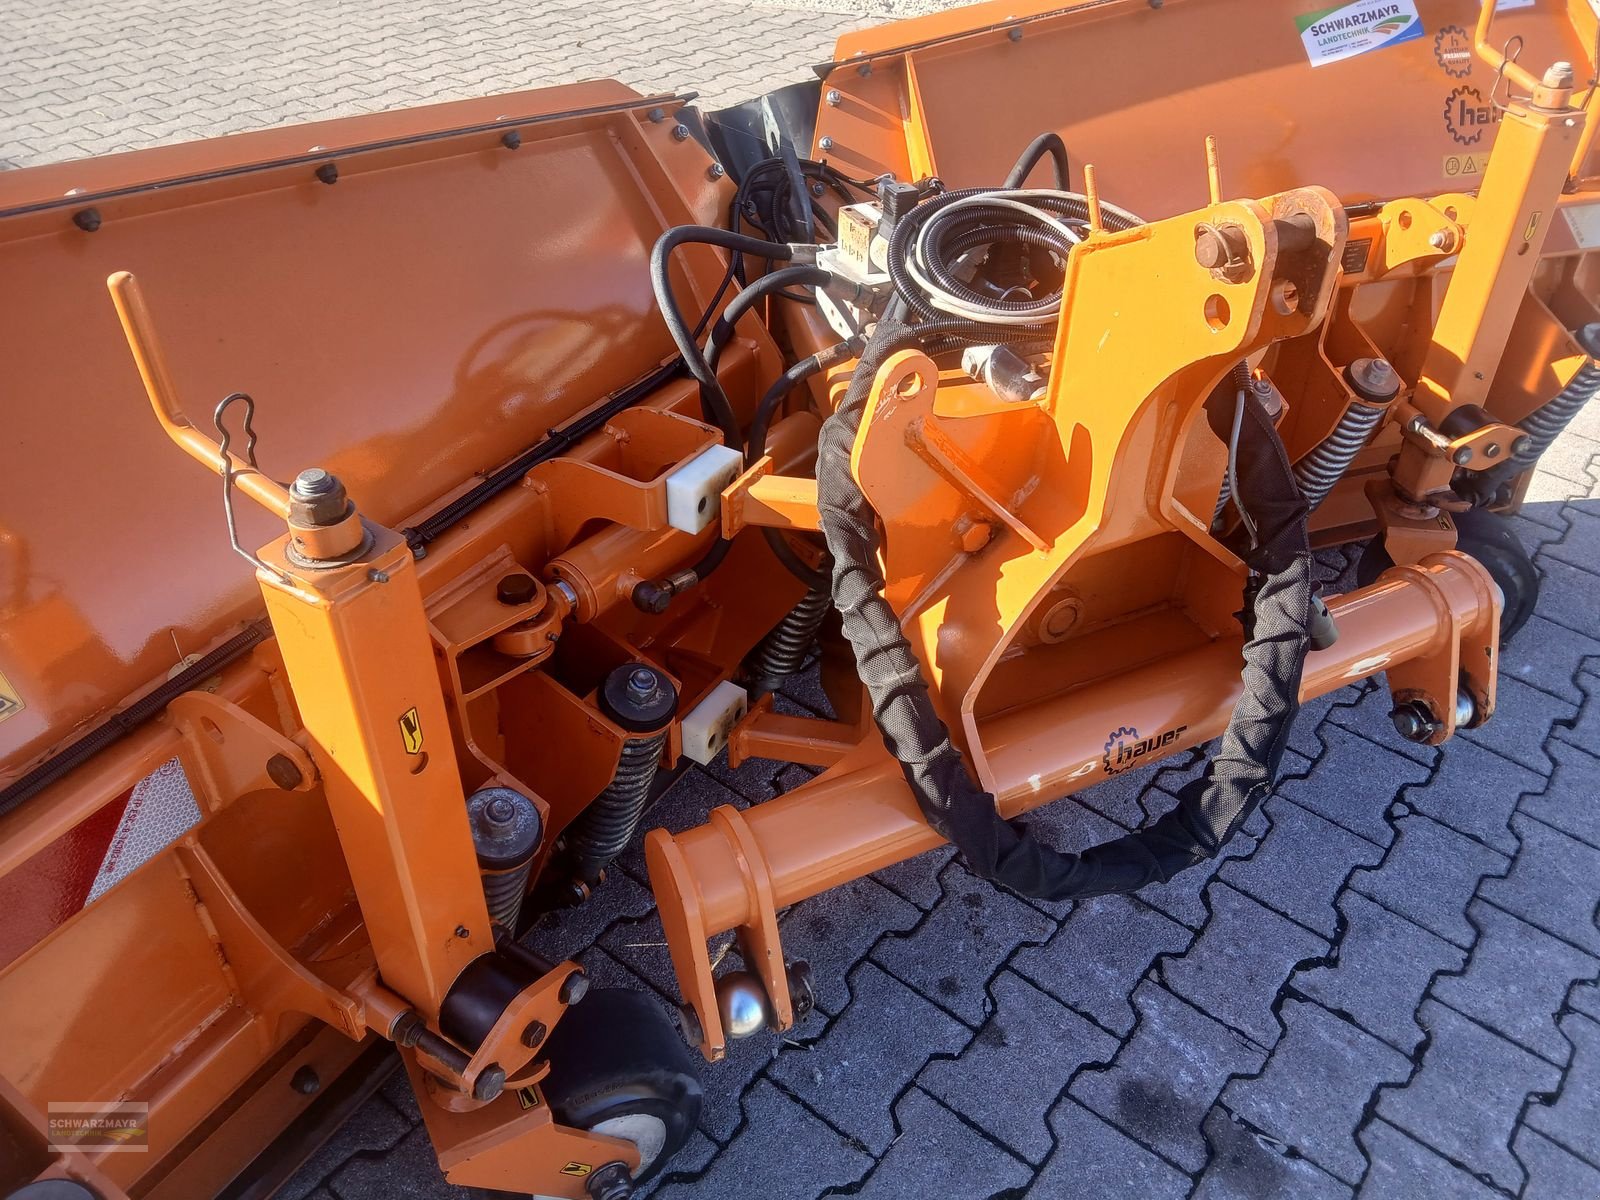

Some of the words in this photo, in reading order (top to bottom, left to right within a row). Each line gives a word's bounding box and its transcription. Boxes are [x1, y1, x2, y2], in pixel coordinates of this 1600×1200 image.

[1311, 4, 1400, 37] SCHWARZMAYR
[1317, 27, 1370, 46] LANDTECHNIK
[1117, 726, 1187, 764] hauer
